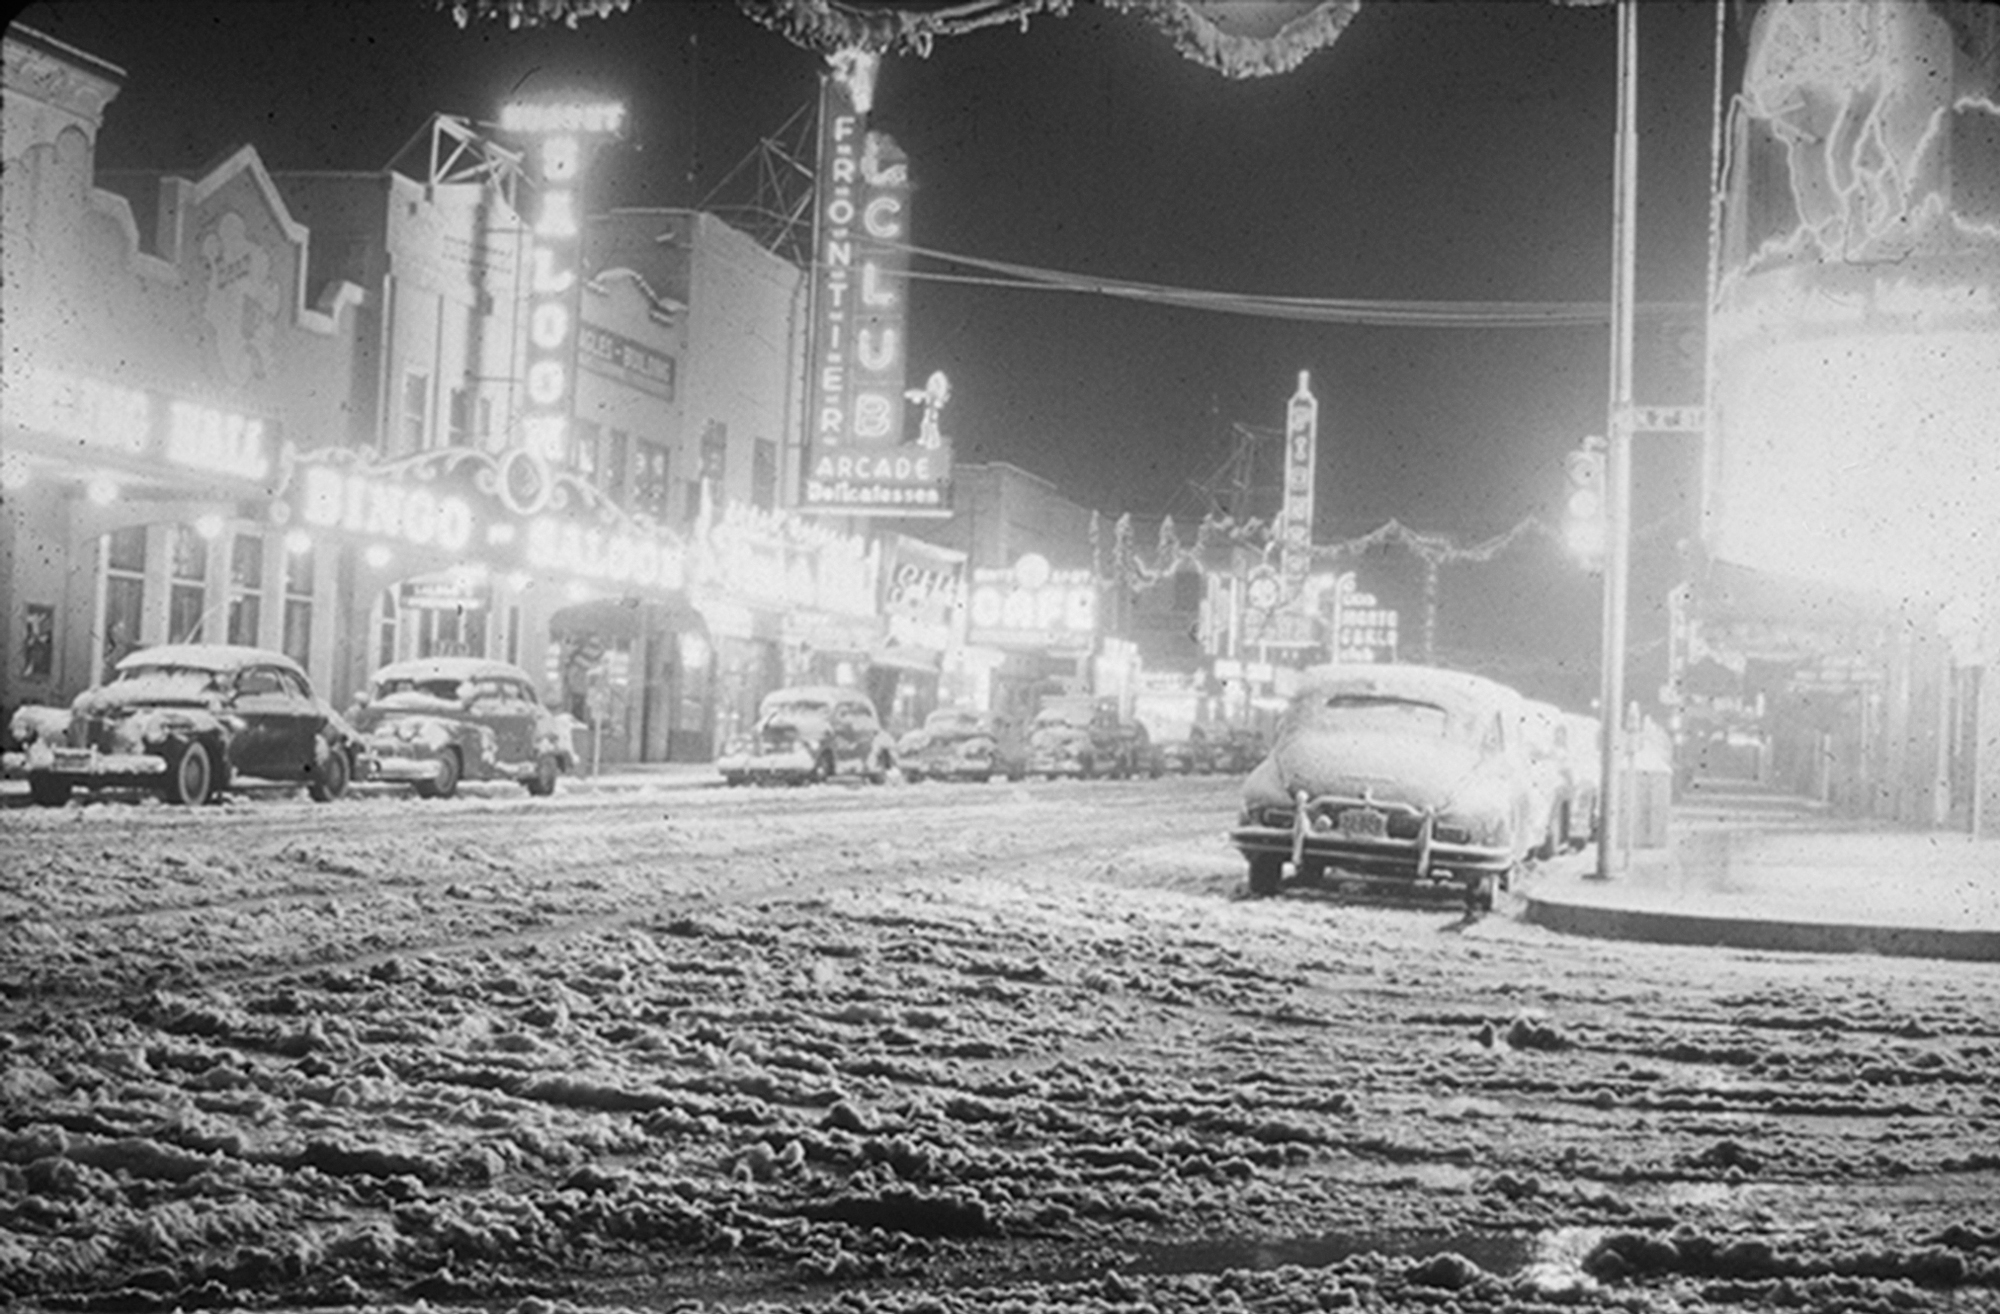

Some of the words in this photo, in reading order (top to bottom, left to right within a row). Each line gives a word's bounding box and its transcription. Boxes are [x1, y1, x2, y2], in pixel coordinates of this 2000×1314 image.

[854, 196, 904, 437] CLUB
[300, 465, 469, 552] BINGO
[813, 455, 935, 483] ARCADE
